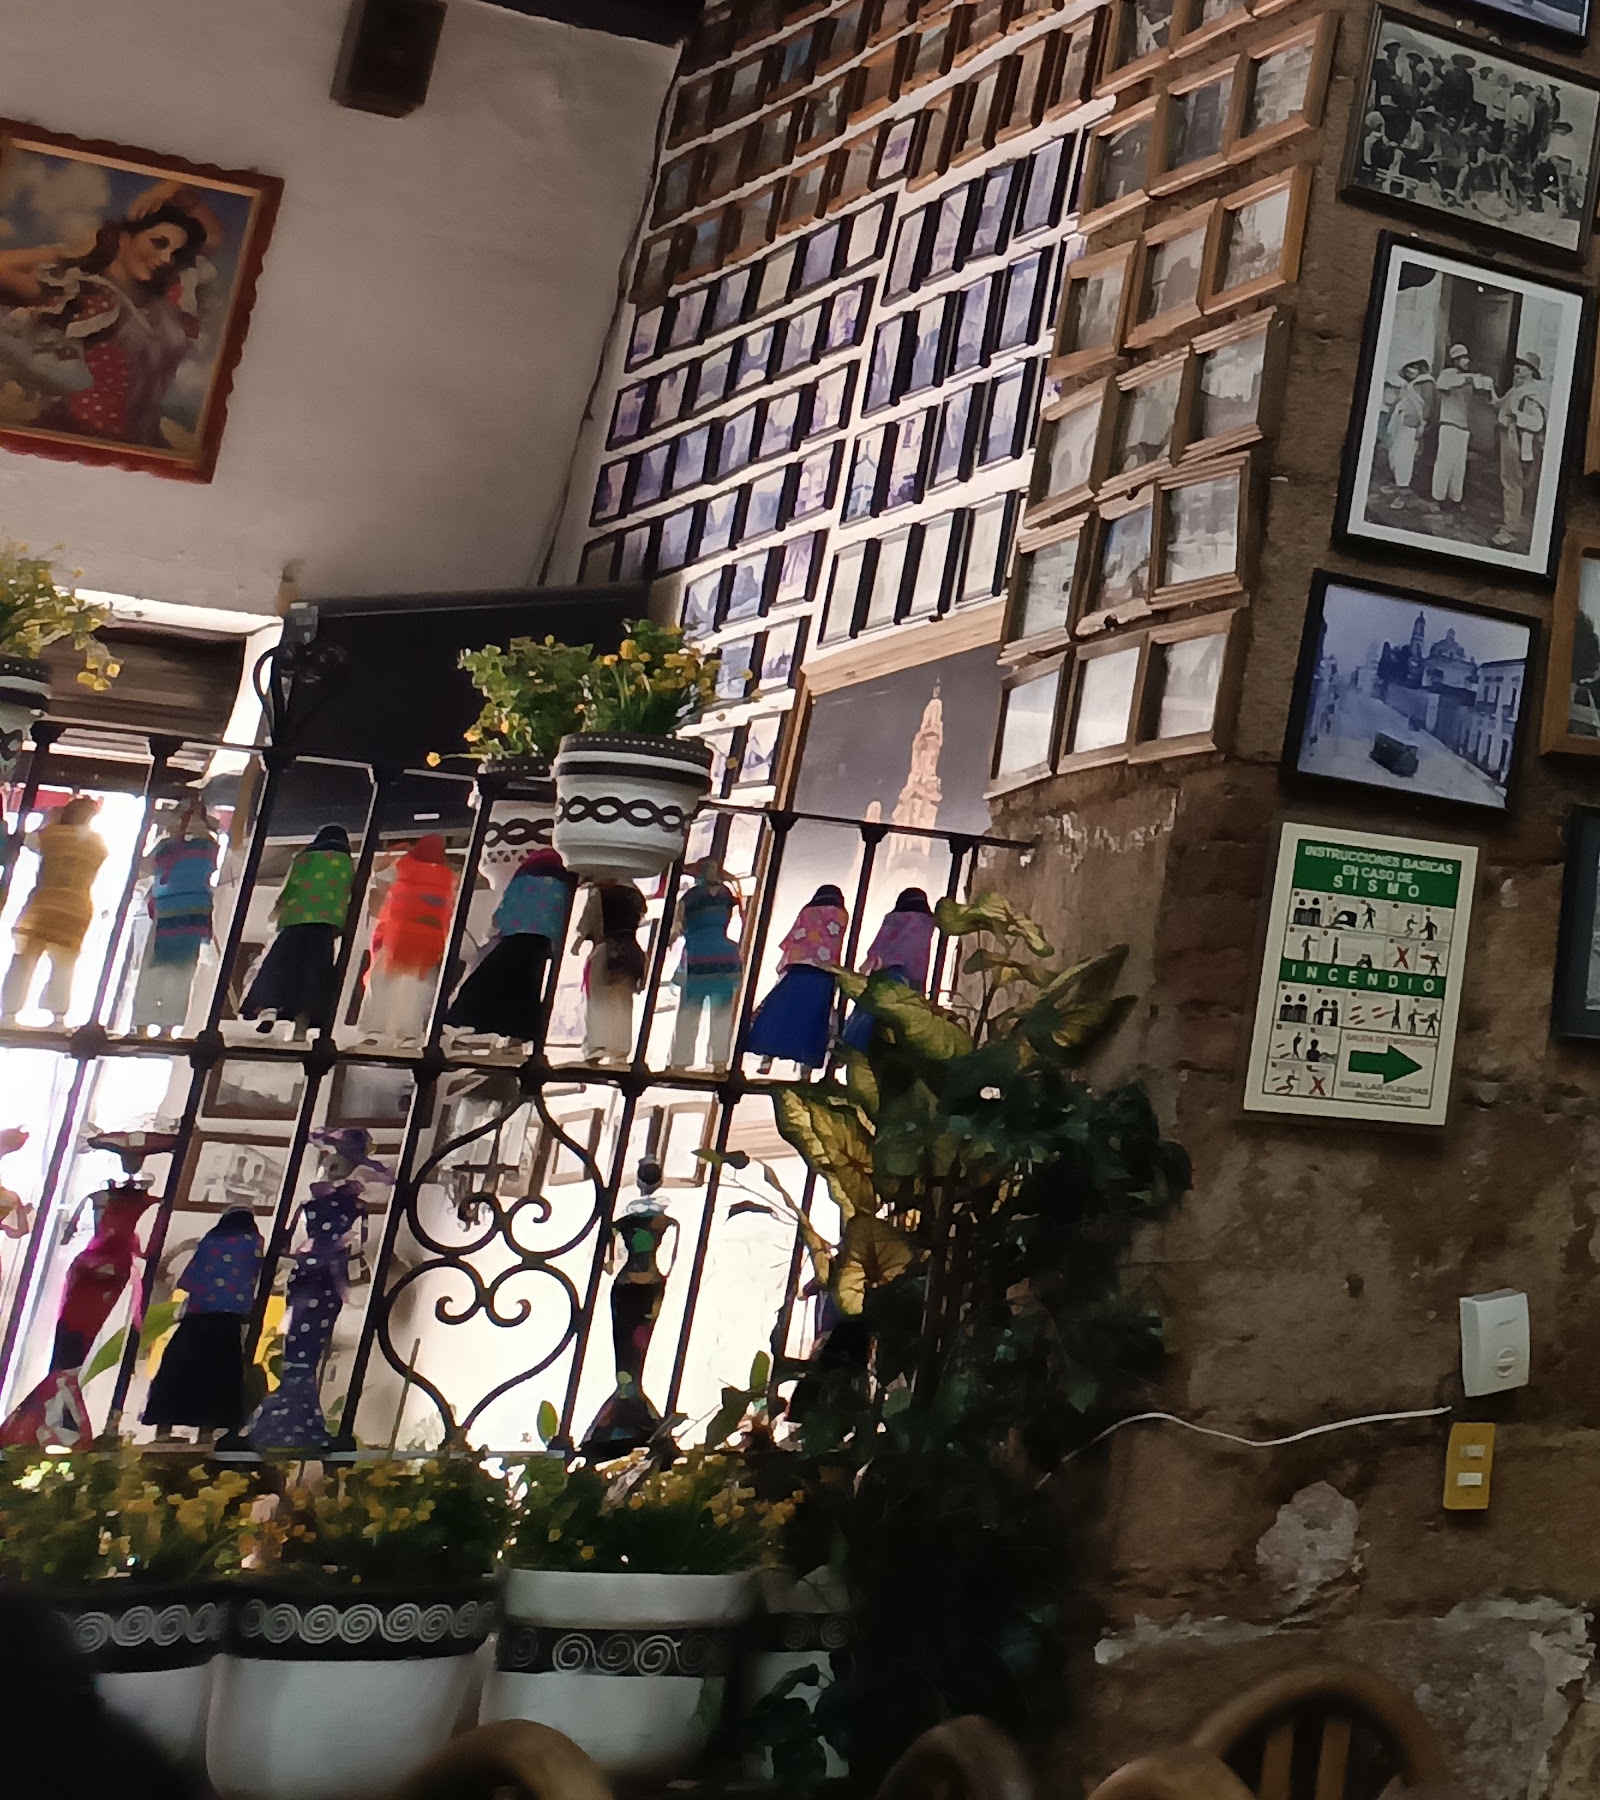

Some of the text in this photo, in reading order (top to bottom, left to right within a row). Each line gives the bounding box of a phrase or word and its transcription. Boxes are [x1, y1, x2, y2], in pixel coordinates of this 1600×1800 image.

[1304, 845, 1400, 868] INSTRUCCIONES
[1342, 864, 1414, 884] EN CASO DE
[1332, 874, 1420, 898] SISMO
[1290, 963, 1436, 993] INCENDIO
